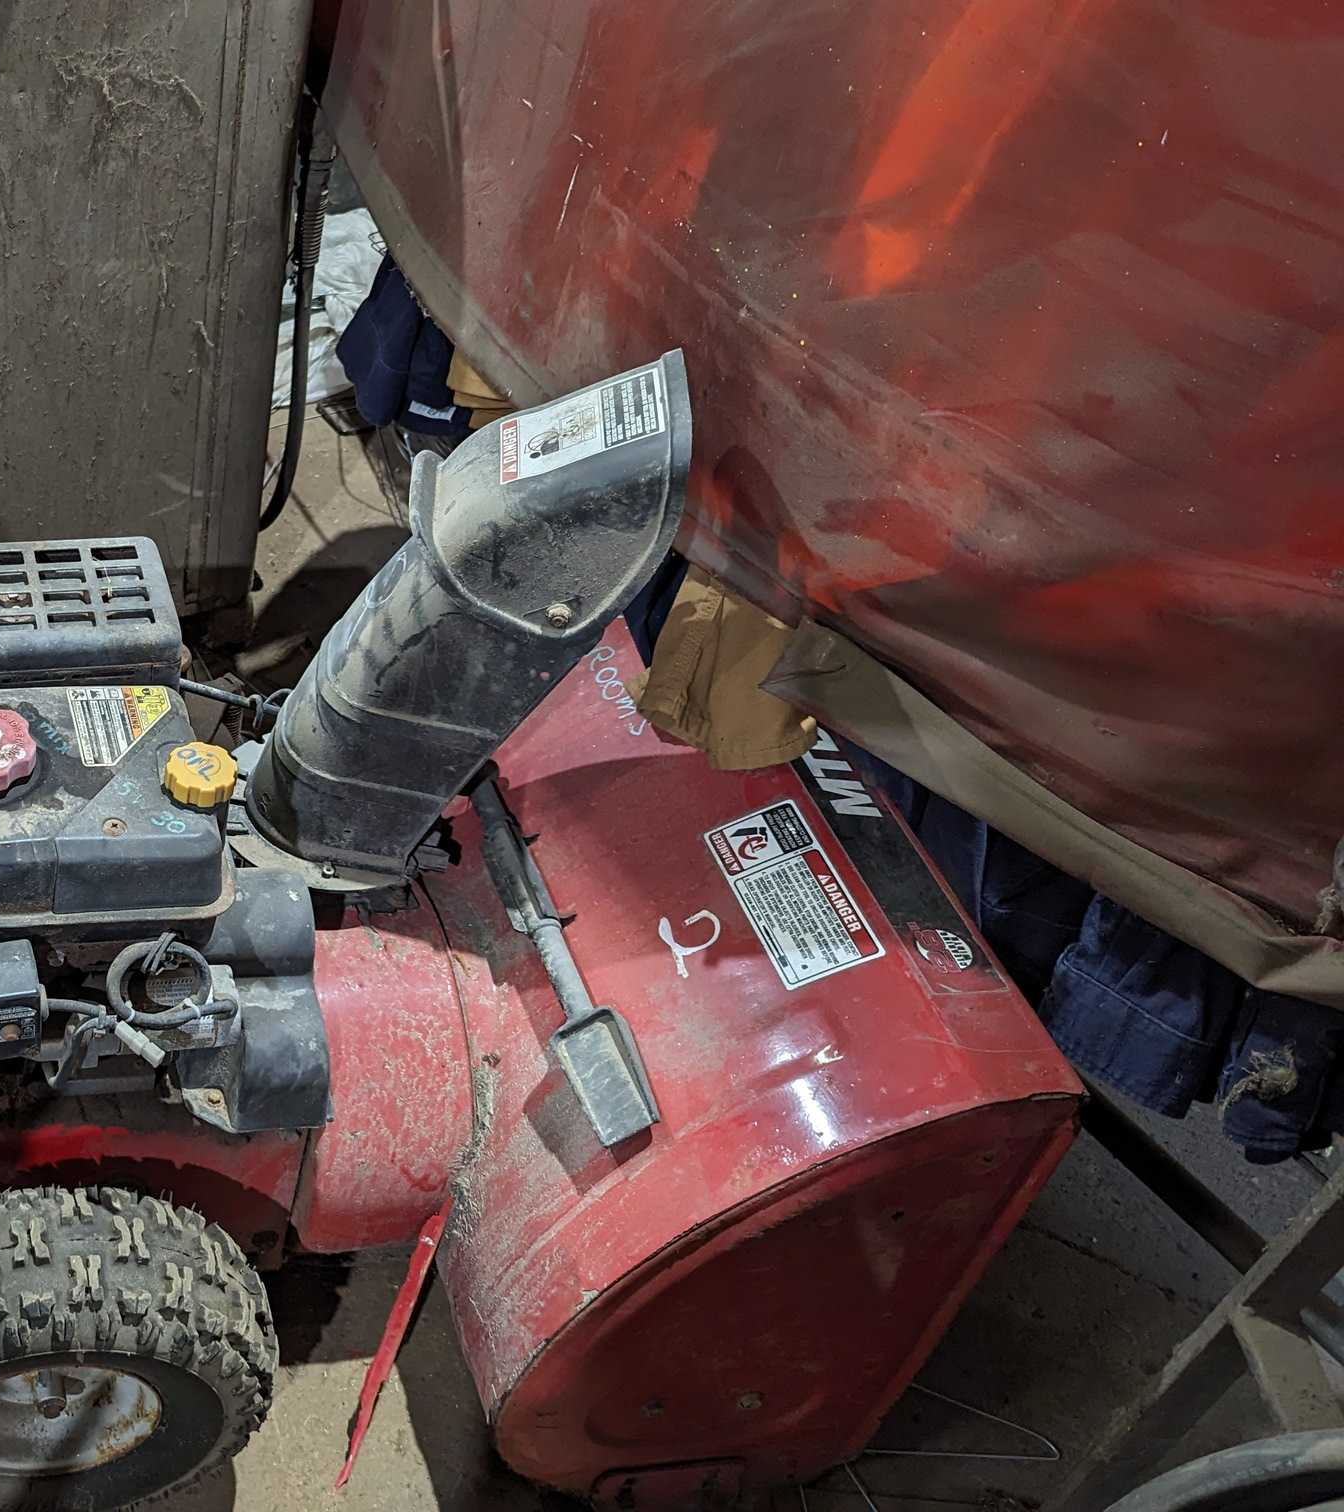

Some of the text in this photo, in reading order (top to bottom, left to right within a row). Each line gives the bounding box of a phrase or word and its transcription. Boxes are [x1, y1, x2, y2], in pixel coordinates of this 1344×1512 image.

[505, 426, 519, 464] DANGER
[124, 698, 140, 730] WARNING
[151, 811, 186, 833] 30
[710, 831, 735, 865] DANGER
[822, 881, 862, 933] DANGER
